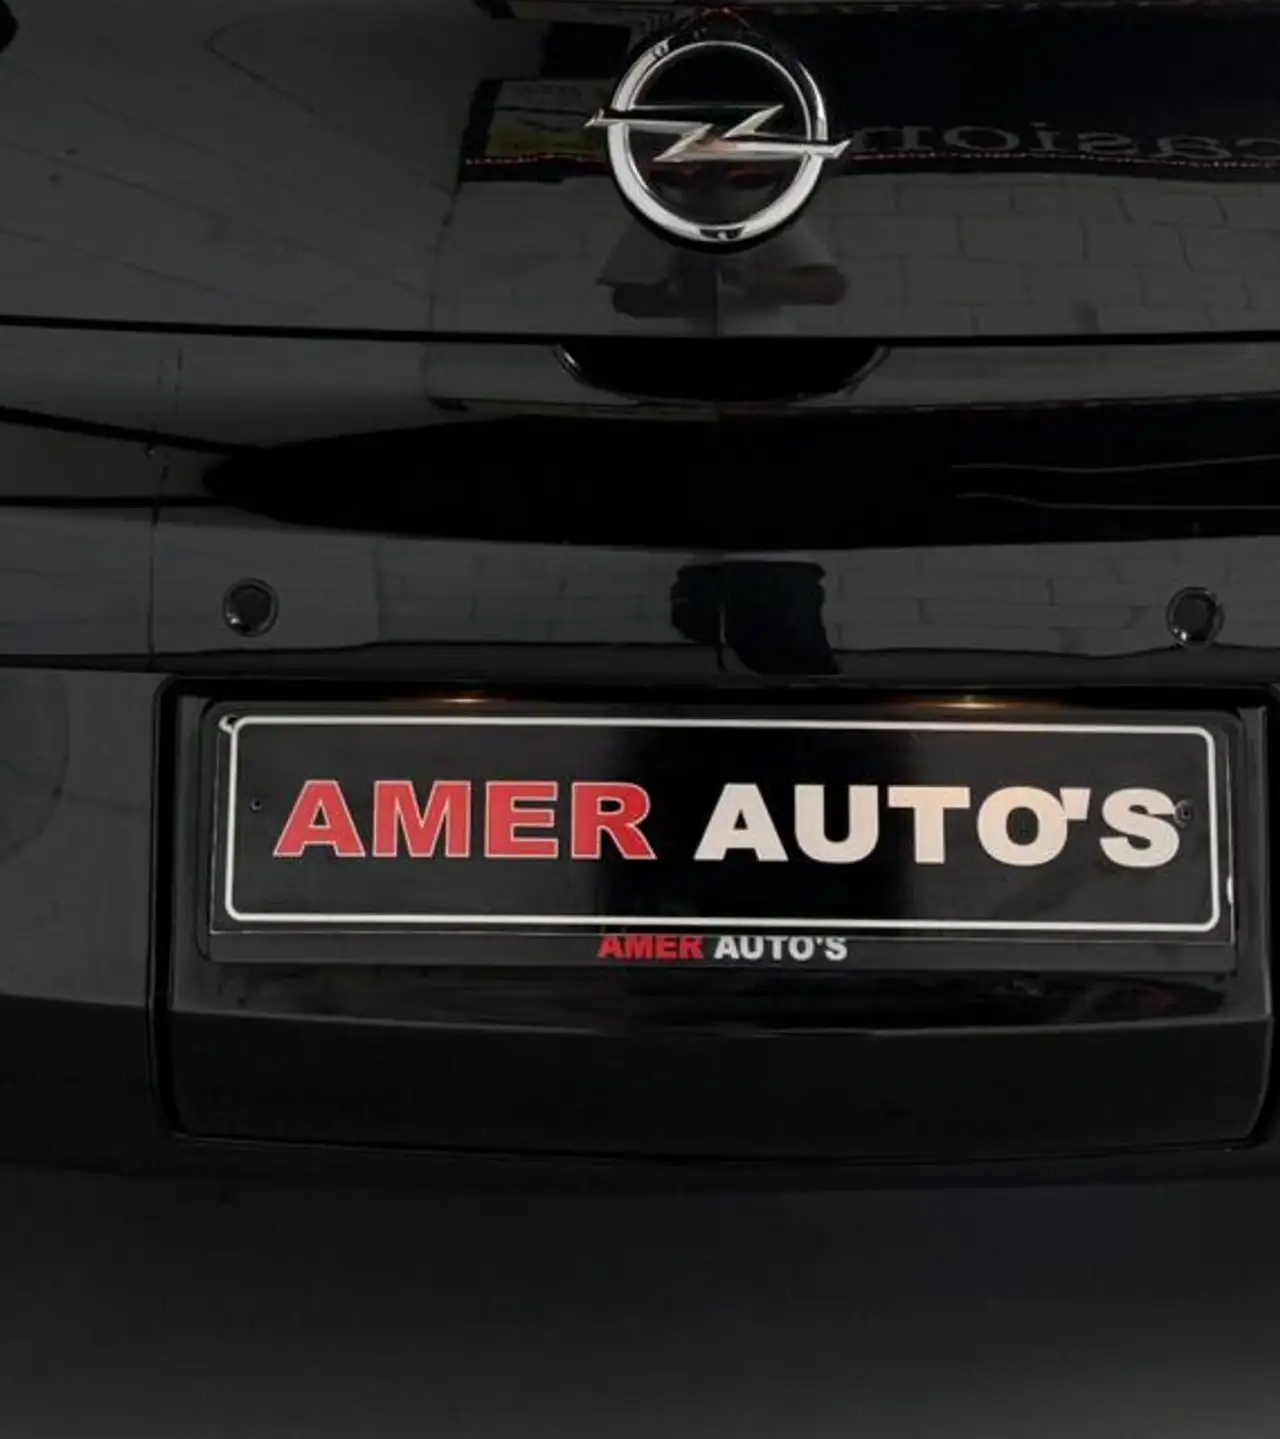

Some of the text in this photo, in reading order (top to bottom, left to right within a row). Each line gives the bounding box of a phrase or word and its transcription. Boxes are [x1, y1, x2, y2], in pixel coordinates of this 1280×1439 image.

[272, 779, 1184, 867] AMER AUTO'S
[597, 934, 848, 961] AMER AUTO'S
